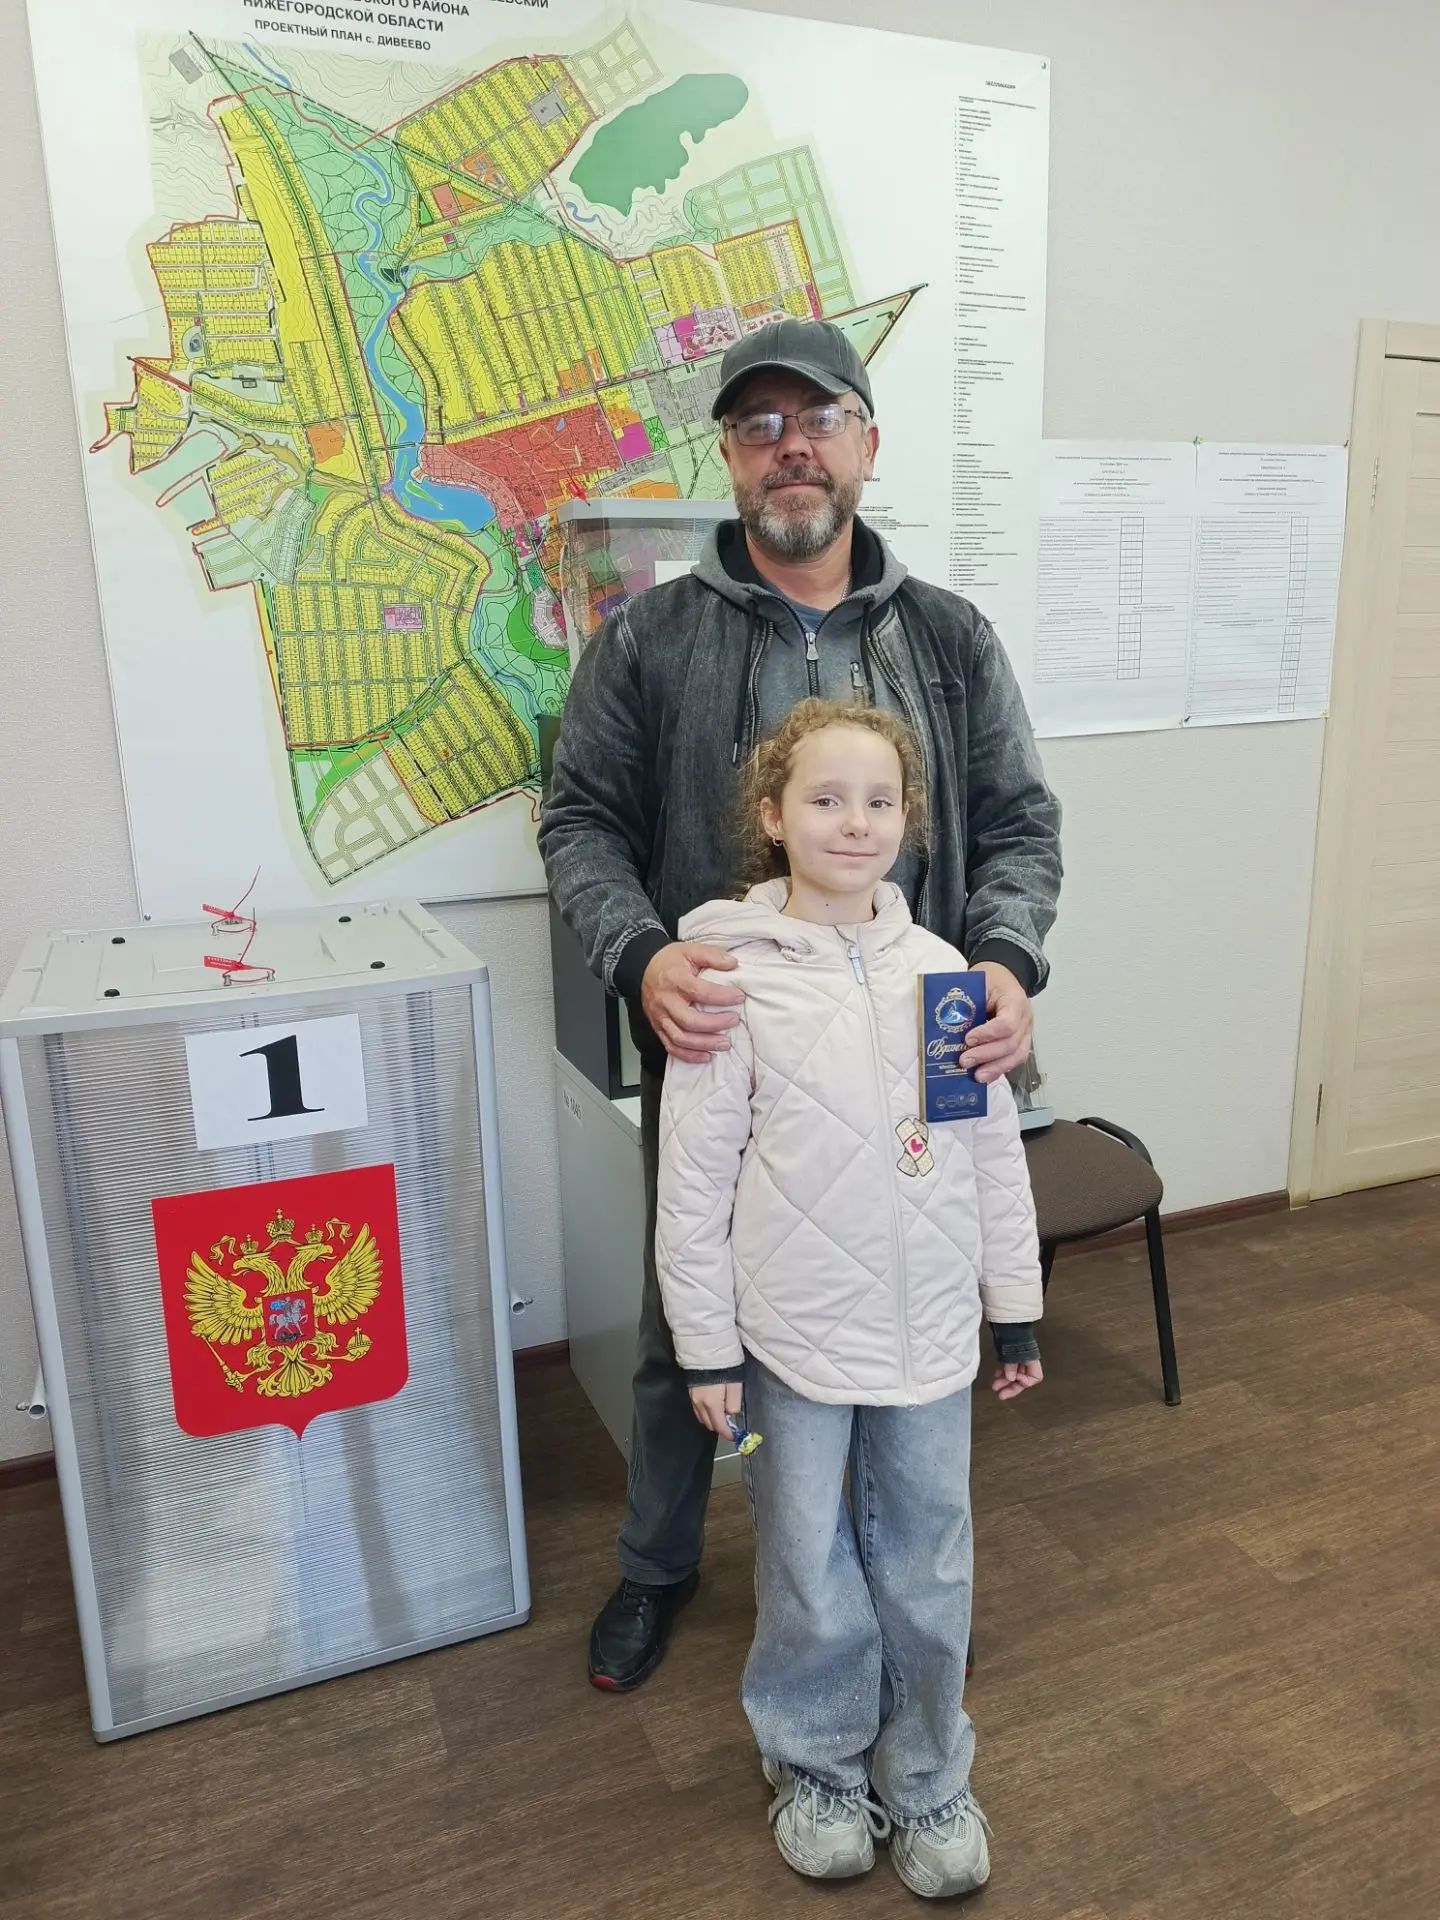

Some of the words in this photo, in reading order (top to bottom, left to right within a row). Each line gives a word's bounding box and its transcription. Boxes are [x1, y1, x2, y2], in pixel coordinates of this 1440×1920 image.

[243, 0, 374, 23] НИЖЕГОРОДСКОЙ
[377, 13, 444, 33] ОБЛАСТИ
[413, 0, 470, 17] РАЙОНА
[254, 19, 328, 38] ПРОЕКТНЫЙ
[331, 29, 362, 42] ПЛАН
[377, 35, 431, 50] ДИВЕЕВО
[239, 1034, 325, 1122] 1
